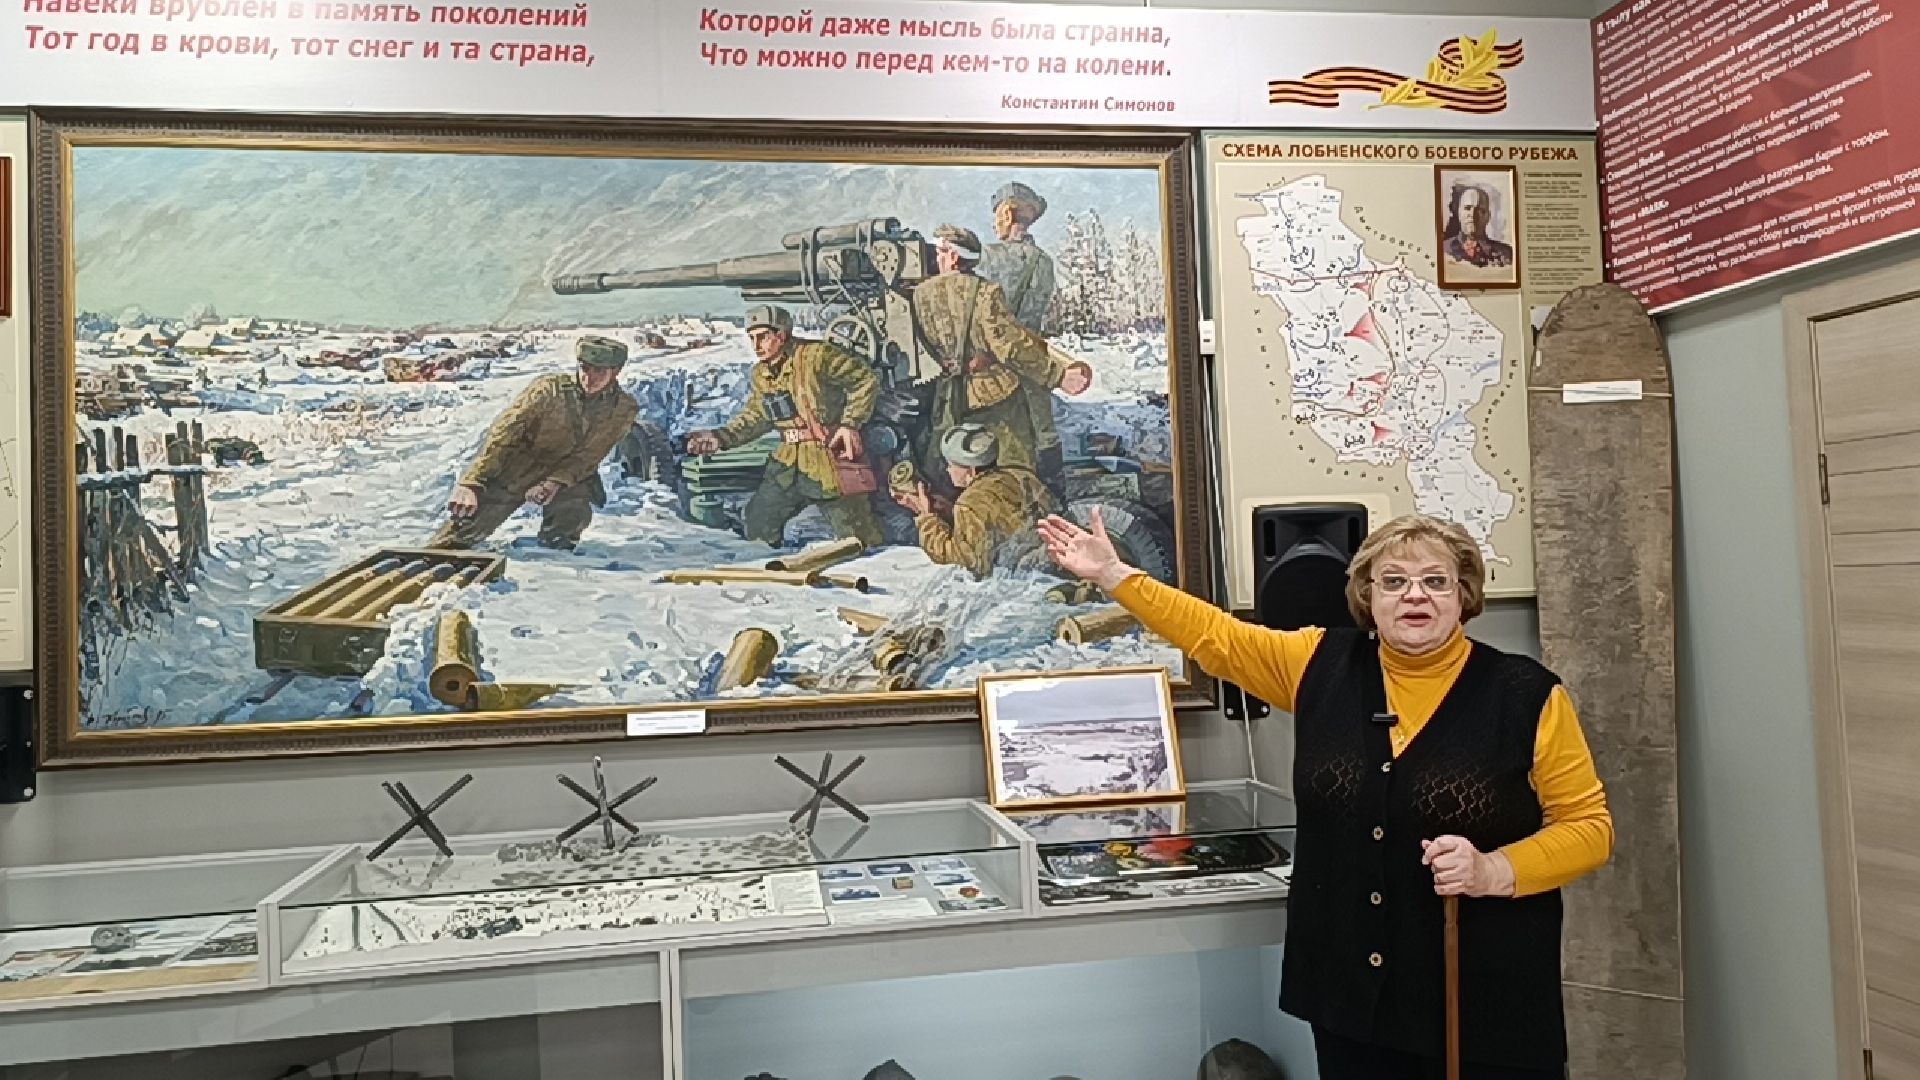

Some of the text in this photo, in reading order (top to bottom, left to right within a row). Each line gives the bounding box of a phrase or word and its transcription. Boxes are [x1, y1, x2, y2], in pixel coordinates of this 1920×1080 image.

[149, 0, 278, 21] врублен
[288, 2, 303, 19] в
[314, 3, 421, 22] память
[431, 3, 587, 27] поколений
[1796, 0, 1829, 22] завод
[700, 8, 1171, 48] Которой даже мысль была странна,
[25, 25, 595, 67] Тот год в крови, тот снег и та страна,
[701, 43, 1172, 77] Что можно перед кем-то на колени.
[1001, 94, 1176, 113] Константин Симонов
[1850, 128, 1890, 149] торфом.
[1222, 143, 1579, 161] СХЕМА ЛОБНЕНСКОГО БОЕВОГО РУБЕЖА
[1842, 198, 1871, 216] фронт
